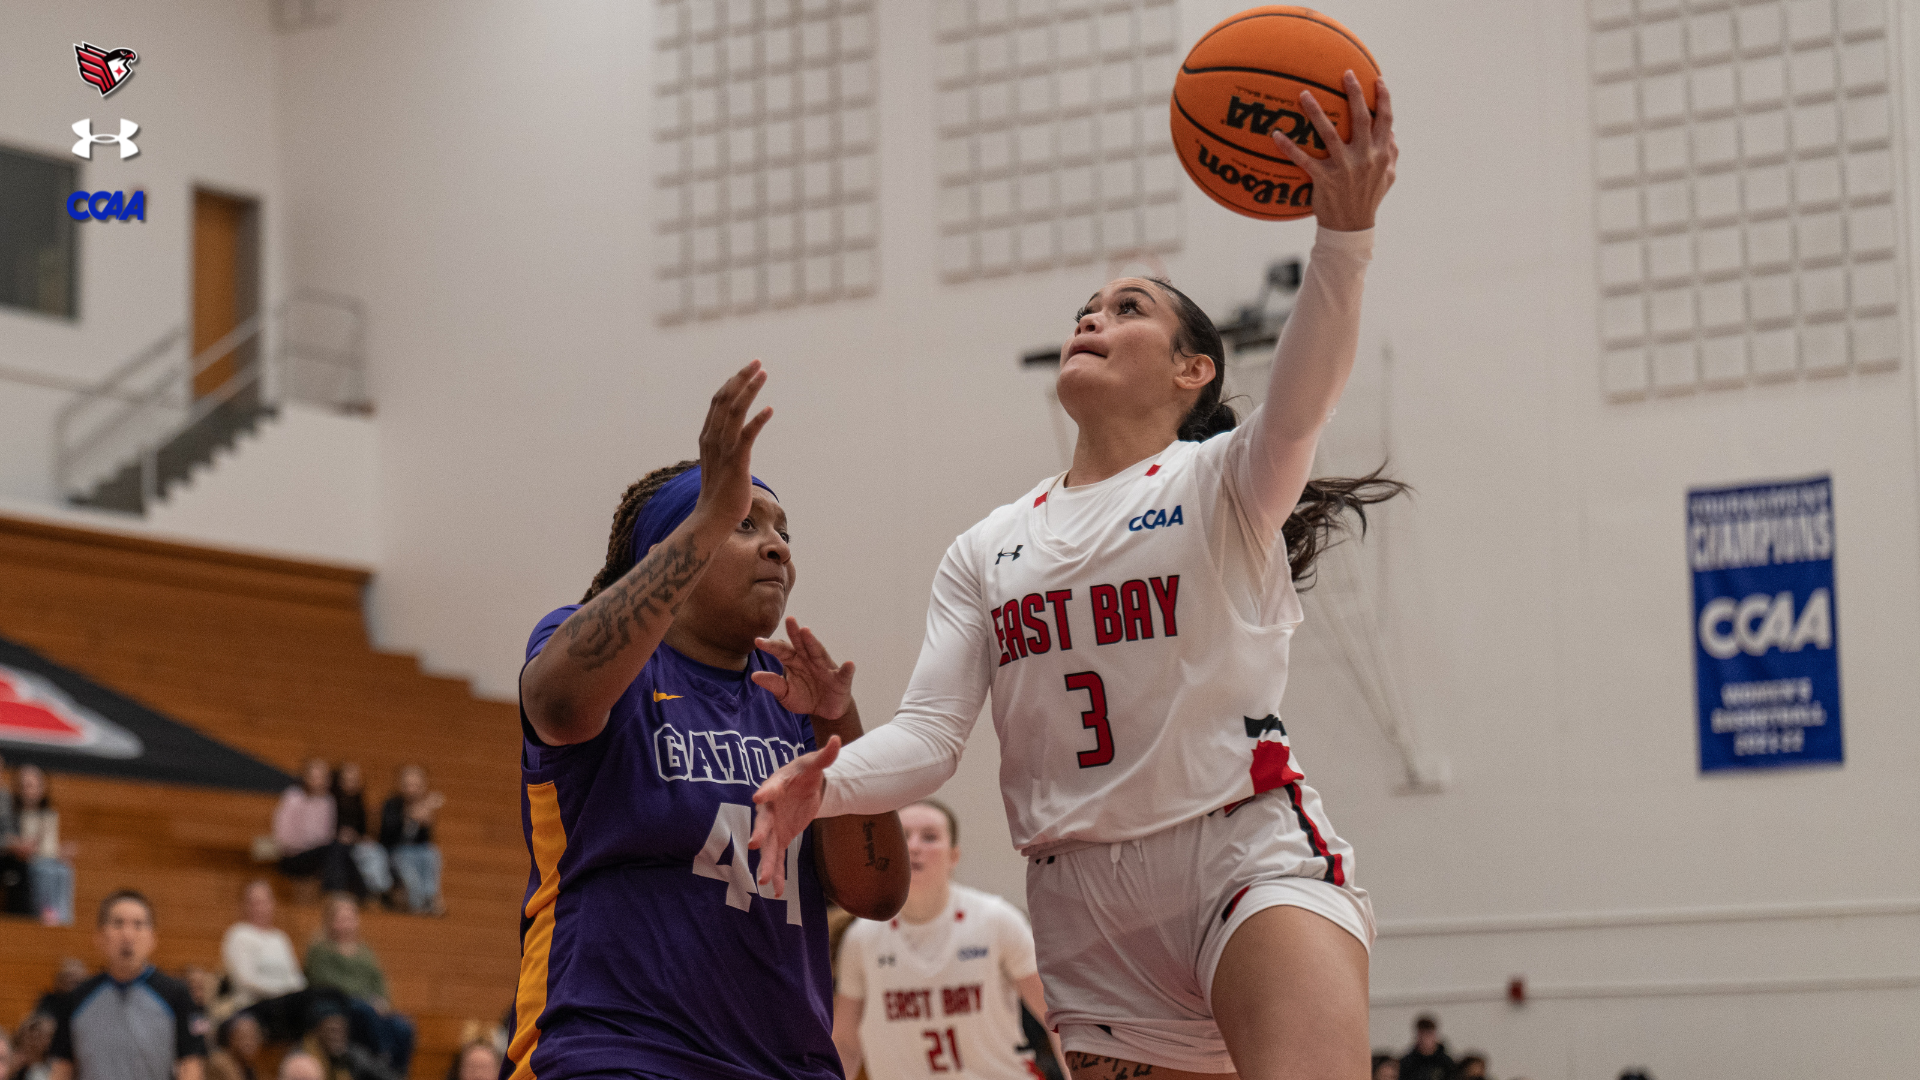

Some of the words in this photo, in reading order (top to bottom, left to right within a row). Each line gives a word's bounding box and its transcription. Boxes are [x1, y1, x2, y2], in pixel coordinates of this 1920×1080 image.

[1128, 504, 1184, 532] CCAA
[1691, 512, 1831, 572] CHAMPIONS
[990, 588, 1073, 668] EAST
[1089, 574, 1181, 647] BAY
[1699, 587, 1832, 660] CCAA
[1063, 670, 1115, 769] 3
[653, 723, 805, 790] GATOR
[883, 986, 933, 1022] EAST
[940, 981, 983, 1016] BAY
[921, 1025, 964, 1074] 21
